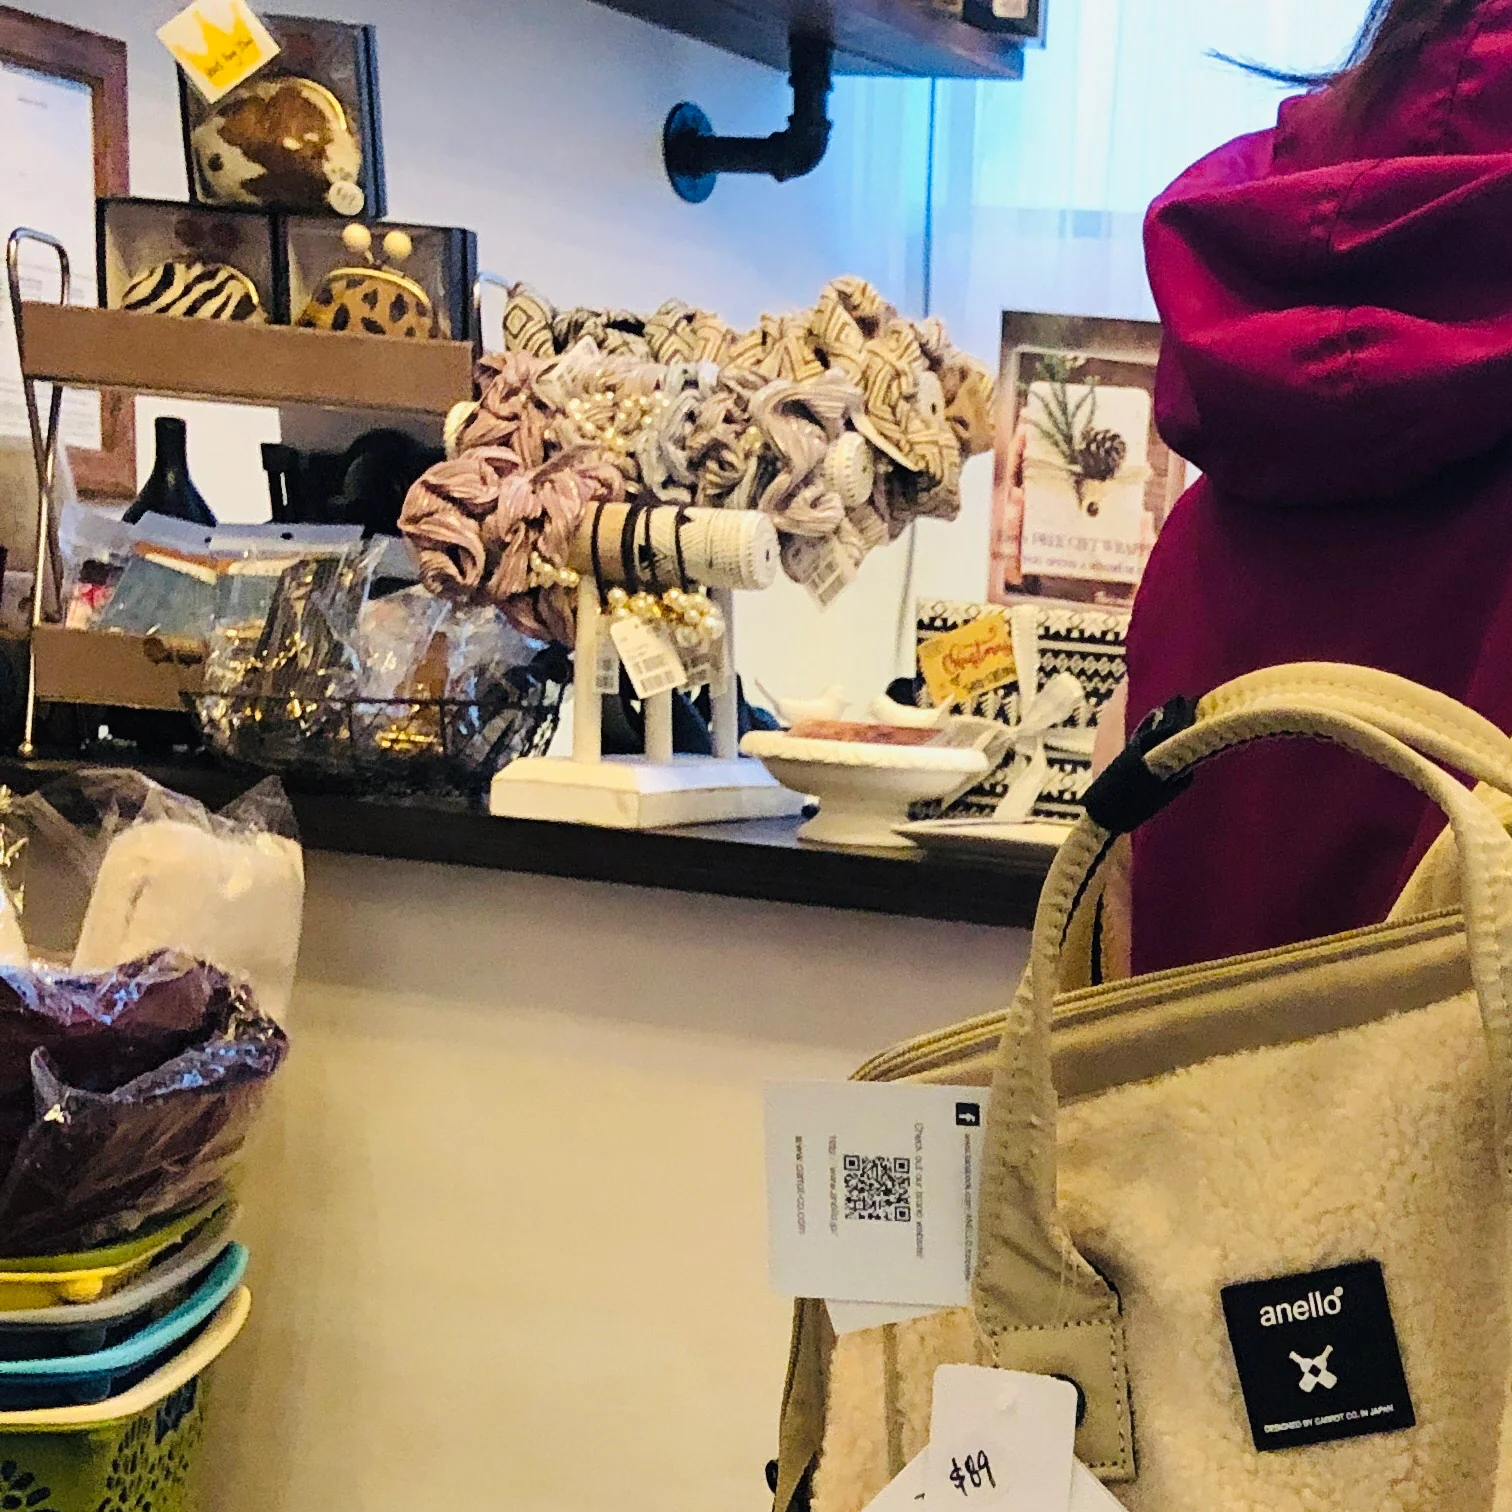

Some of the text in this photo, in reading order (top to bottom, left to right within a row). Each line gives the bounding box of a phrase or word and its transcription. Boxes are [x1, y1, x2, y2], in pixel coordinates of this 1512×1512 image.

[1302, 1417, 1314, 1428] BY
[1314, 1413, 1345, 1427] CARROT
[1370, 1404, 1395, 1417] JAPAN
[948, 1449, 997, 1497] $89
